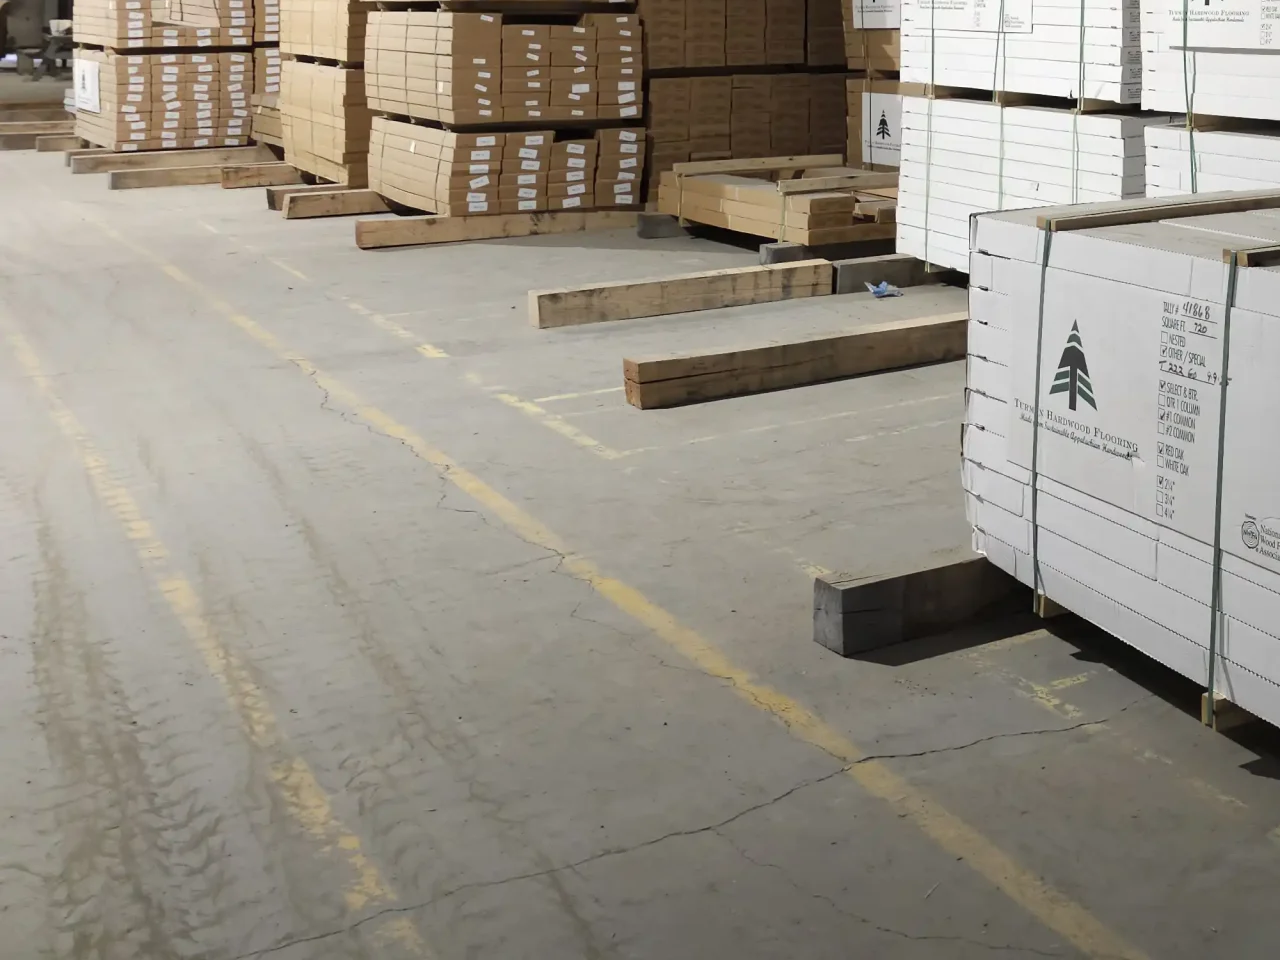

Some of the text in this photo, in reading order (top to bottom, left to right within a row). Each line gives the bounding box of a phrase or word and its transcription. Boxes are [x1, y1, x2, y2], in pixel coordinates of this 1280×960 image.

[1163, 301, 1175, 314] TALLY
[1161, 316, 1180, 331] SQUARE
[1169, 333, 1186, 348] NESTED
[1168, 347, 1183, 361] OTHER
[1188, 351, 1207, 368] SPECIAL
[1166, 382, 1182, 397] SELECT
[1180, 400, 1200, 417] COLUMN
[1014, 398, 1138, 453] TURMN HARDWOOD FLOORING
[1173, 412, 1196, 430] COMMON
[1173, 426, 1195, 444] COMMON
[1165, 443, 1185, 461] RED OAK
[1260, 534, 1276, 549] Wood
